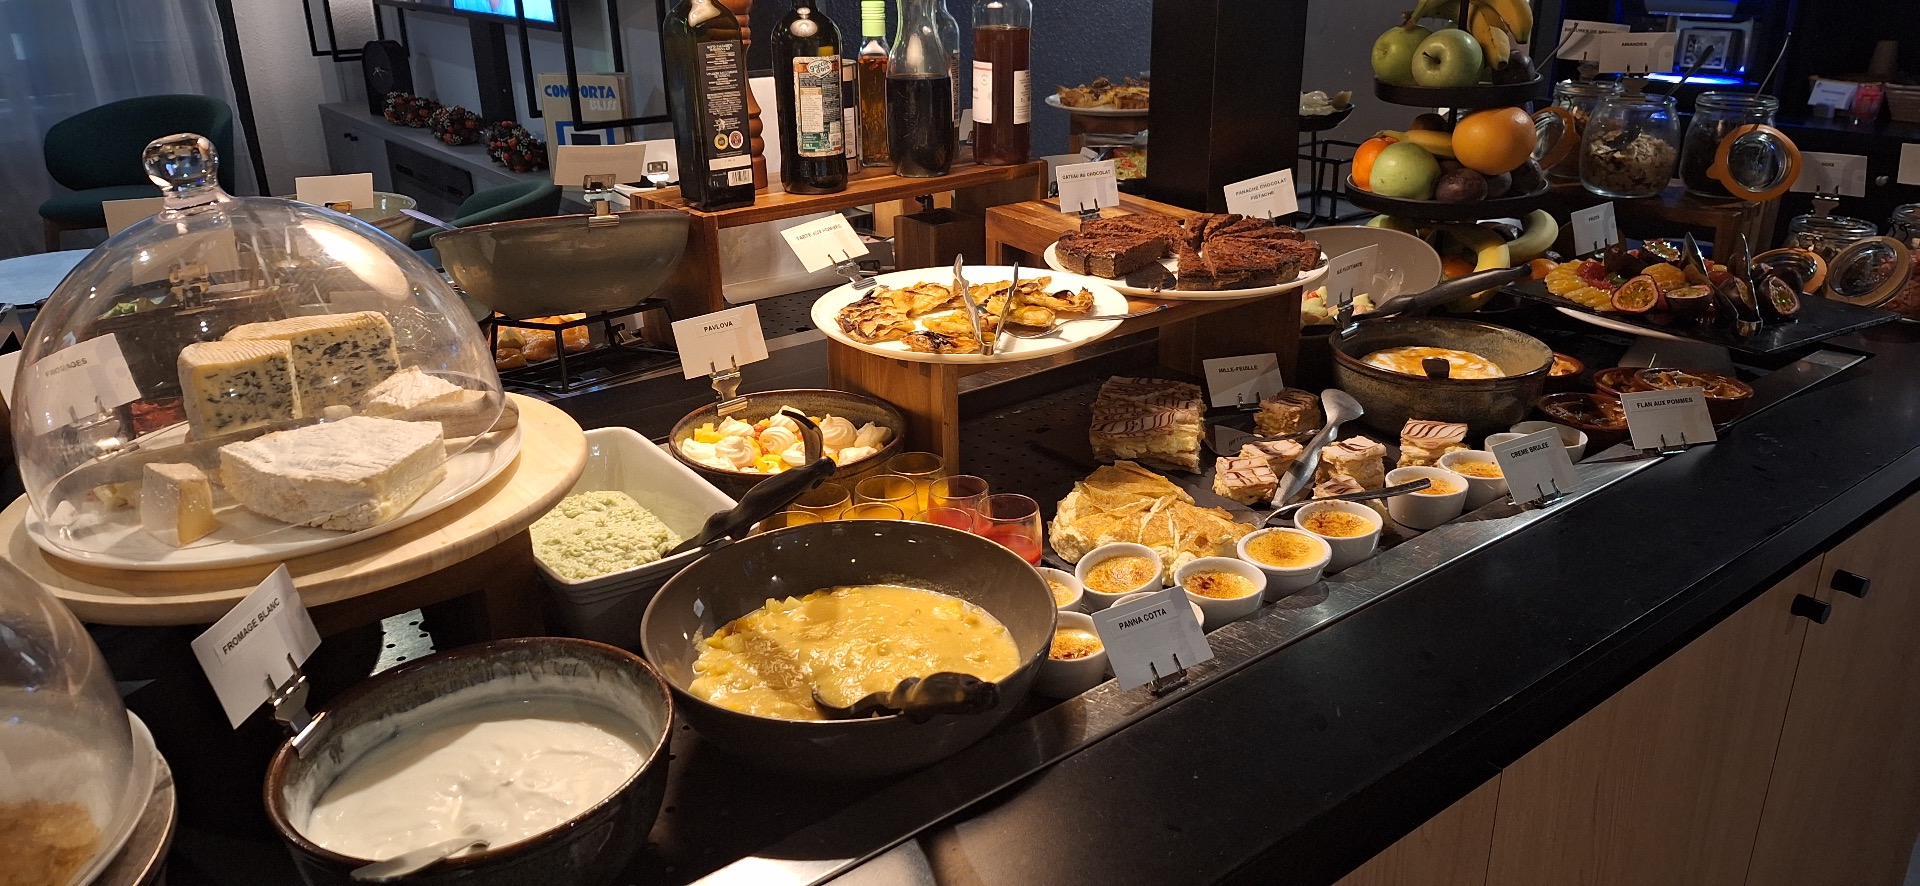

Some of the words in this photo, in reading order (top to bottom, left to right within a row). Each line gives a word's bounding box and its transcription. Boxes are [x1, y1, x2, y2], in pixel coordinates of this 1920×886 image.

[544, 84, 616, 98] COMORTA
[589, 99, 617, 111] BLISS
[1086, 169, 1111, 177] CHOCOLAT
[1235, 185, 1259, 196] PANACHE
[1259, 177, 1287, 189] CHOCOLAT
[1250, 190, 1275, 201] PISTACHE
[796, 233, 812, 241] TARTE
[703, 320, 734, 332] PAVLOVA
[1218, 364, 1259, 373] MILLE-FEUILLE
[1636, 401, 1653, 409] FLAN
[1653, 399, 1666, 407] AUX
[1667, 396, 1693, 405] POMMES
[1510, 446, 1530, 458] CREME
[1529, 441, 1550, 453] BRULEE
[1118, 616, 1144, 631] PANNA
[1143, 607, 1168, 622] COTTA
[222, 618, 259, 655] FROMAGE
[257, 597, 280, 622] BLANC
